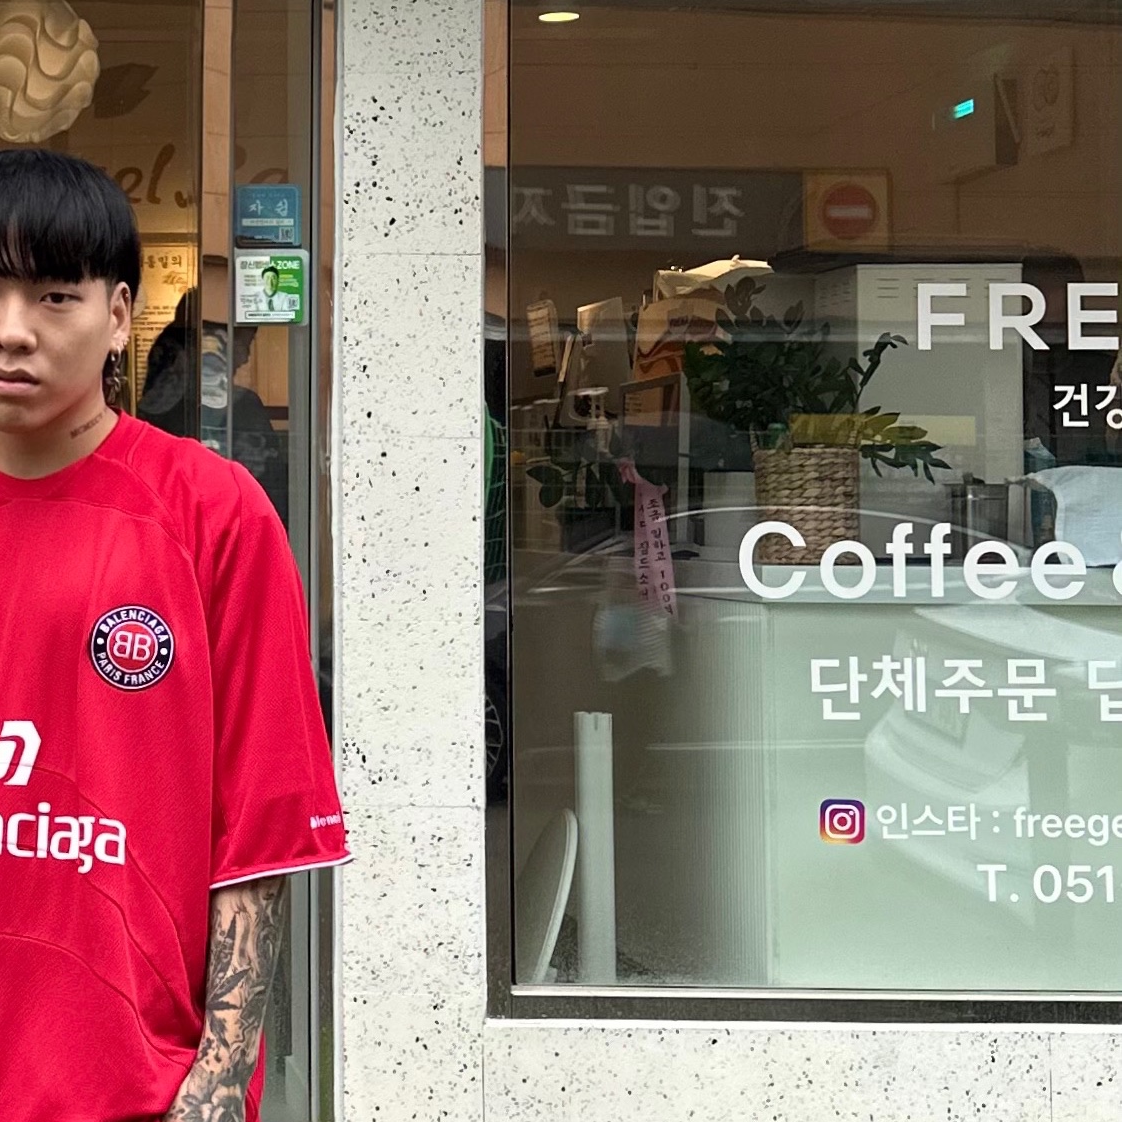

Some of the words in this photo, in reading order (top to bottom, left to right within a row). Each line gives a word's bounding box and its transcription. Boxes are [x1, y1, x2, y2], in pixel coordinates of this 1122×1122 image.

[738, 520, 1088, 600] Coffee
[98, 609, 170, 643] BALENCIAGA
[96, 651, 122, 682] PARIS
[123, 659, 166, 686] FRANCE
[810, 655, 1057, 722] 단체주문
[876, 802, 982, 841] 인스타
[976, 863, 1020, 903] T.
